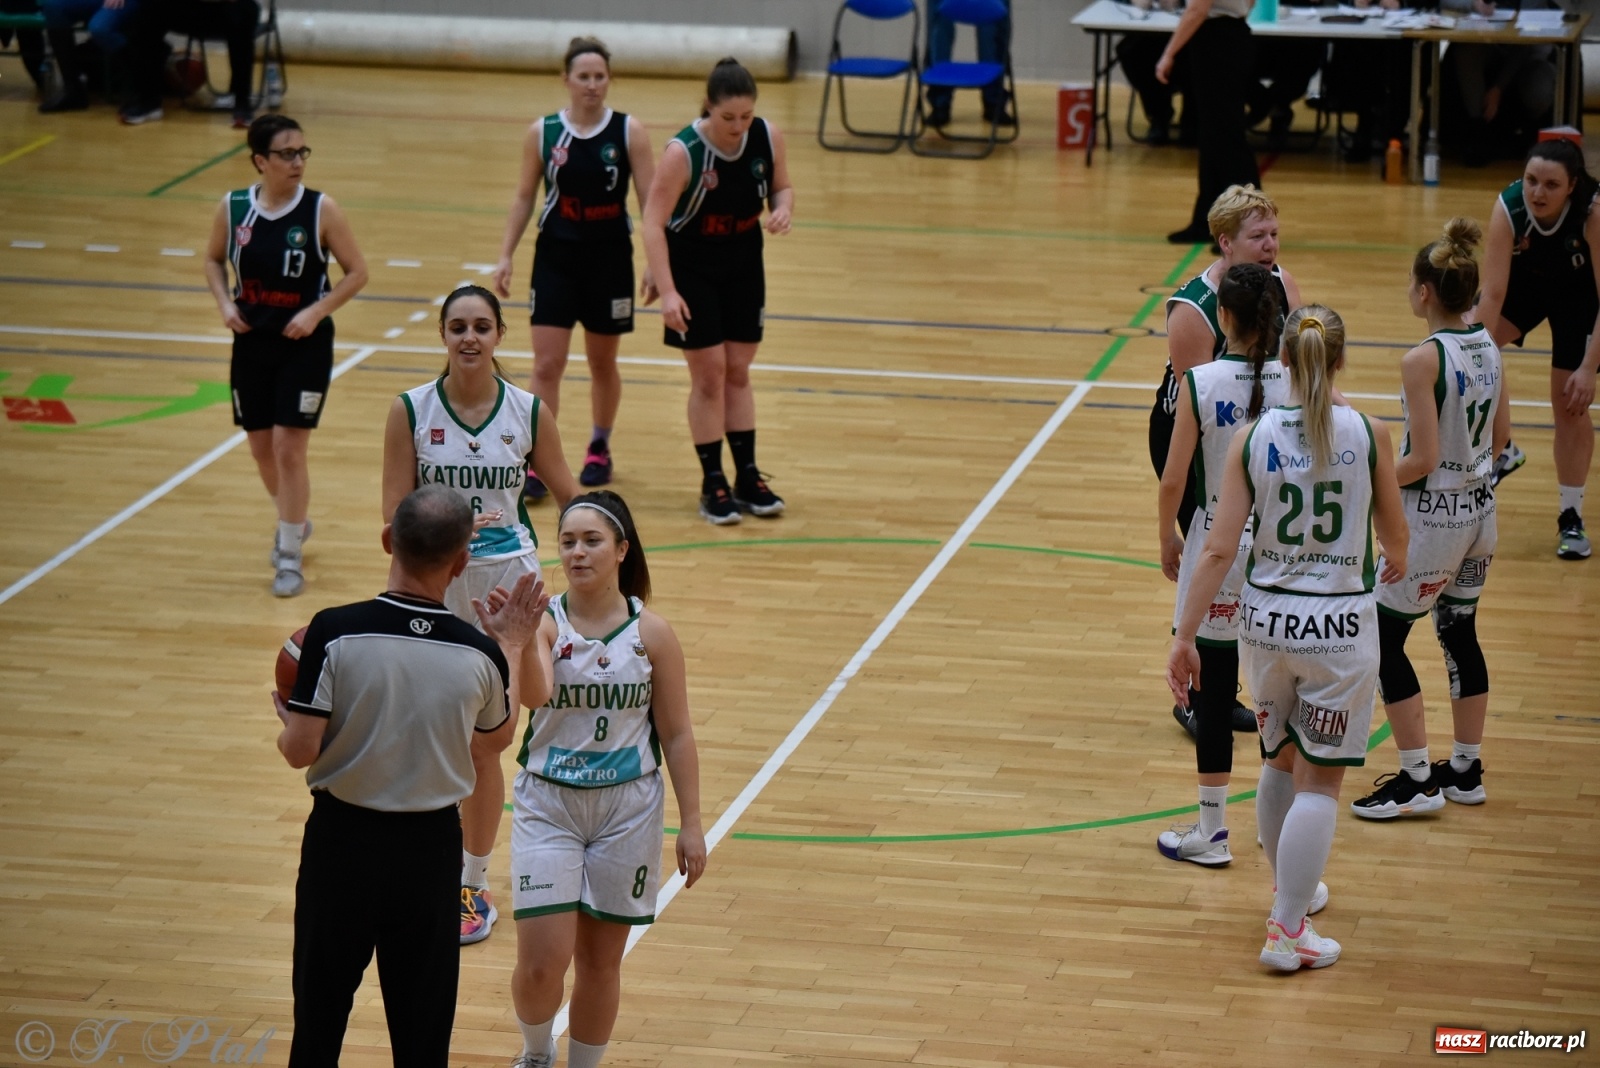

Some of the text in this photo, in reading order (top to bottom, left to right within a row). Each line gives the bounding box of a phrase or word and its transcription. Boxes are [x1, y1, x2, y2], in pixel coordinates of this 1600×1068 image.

[605, 165, 619, 191] 3
[283, 249, 306, 278] 13
[1466, 399, 1492, 449] 11
[421, 463, 521, 489] KATOWICE
[1439, 461, 1463, 472] AZS
[1276, 480, 1343, 546] 25
[1261, 549, 1279, 562] AZS
[1298, 553, 1358, 567] KATOWICE
[1240, 603, 1360, 640] AT-TRANS
[594, 715, 609, 742] 8
[548, 766, 618, 781] ELEKTRO
[551, 754, 589, 768] max
[631, 865, 649, 899] 8
